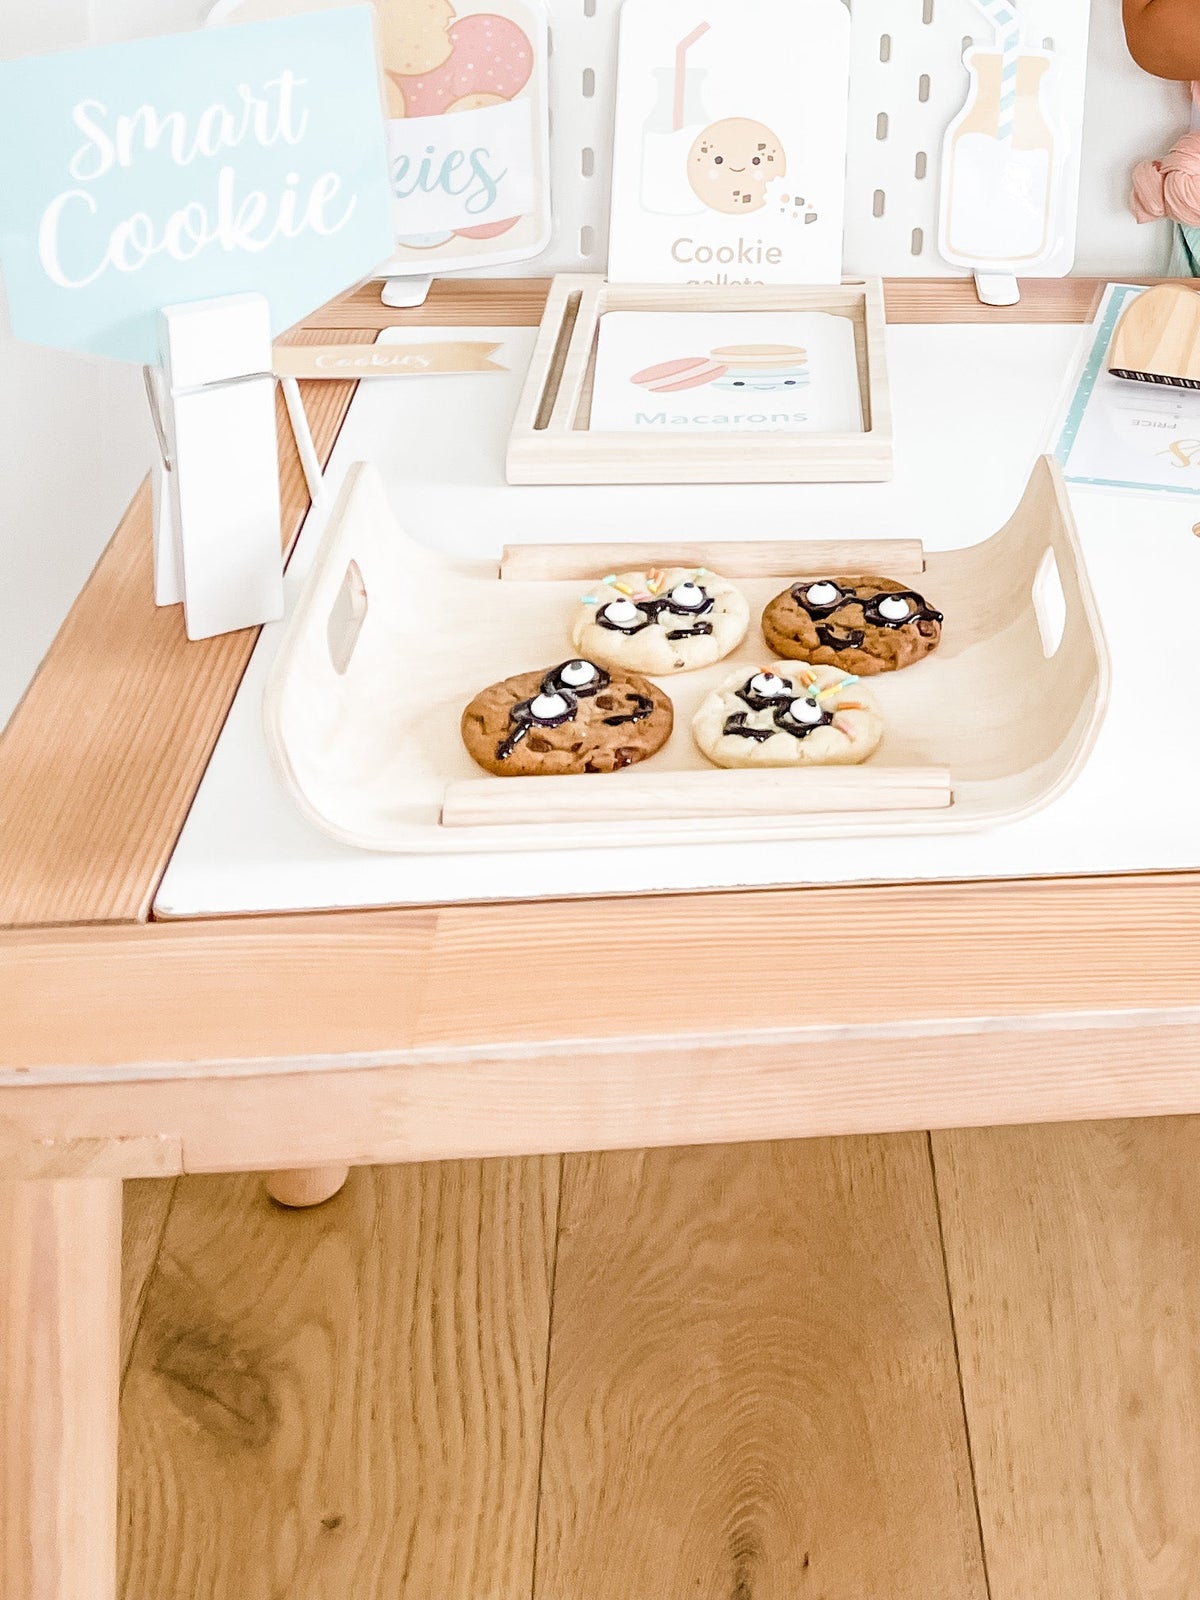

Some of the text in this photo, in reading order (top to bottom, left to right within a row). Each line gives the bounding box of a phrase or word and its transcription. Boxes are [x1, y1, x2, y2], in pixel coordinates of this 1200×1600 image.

[38, 165, 358, 290] Cookie
[671, 238, 783, 265] Cookie
[314, 352, 431, 370] Cookies
[634, 411, 809, 426] Macarons
[1131, 418, 1178, 430] PRICE
